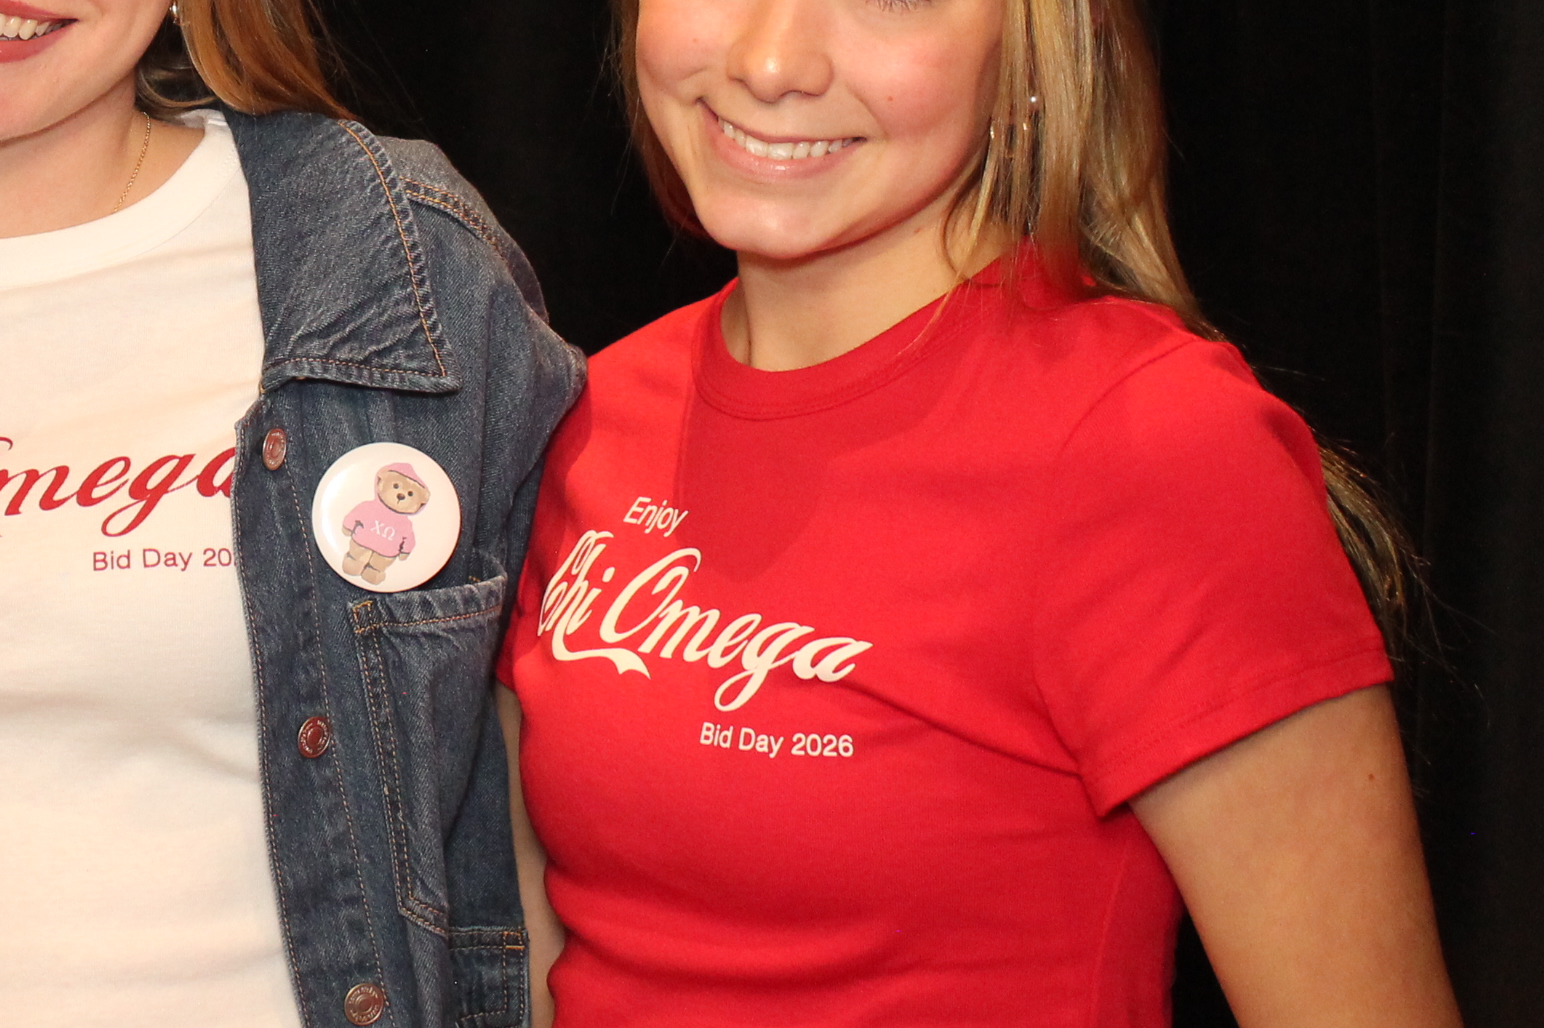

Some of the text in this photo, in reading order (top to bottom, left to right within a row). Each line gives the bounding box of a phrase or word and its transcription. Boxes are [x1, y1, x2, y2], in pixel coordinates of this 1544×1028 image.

[623, 497, 688, 537] Enjoy
[93, 547, 237, 572] Bid Day 20
[537, 530, 873, 712] Chi Omega
[699, 722, 854, 758] Bid Day 2026
